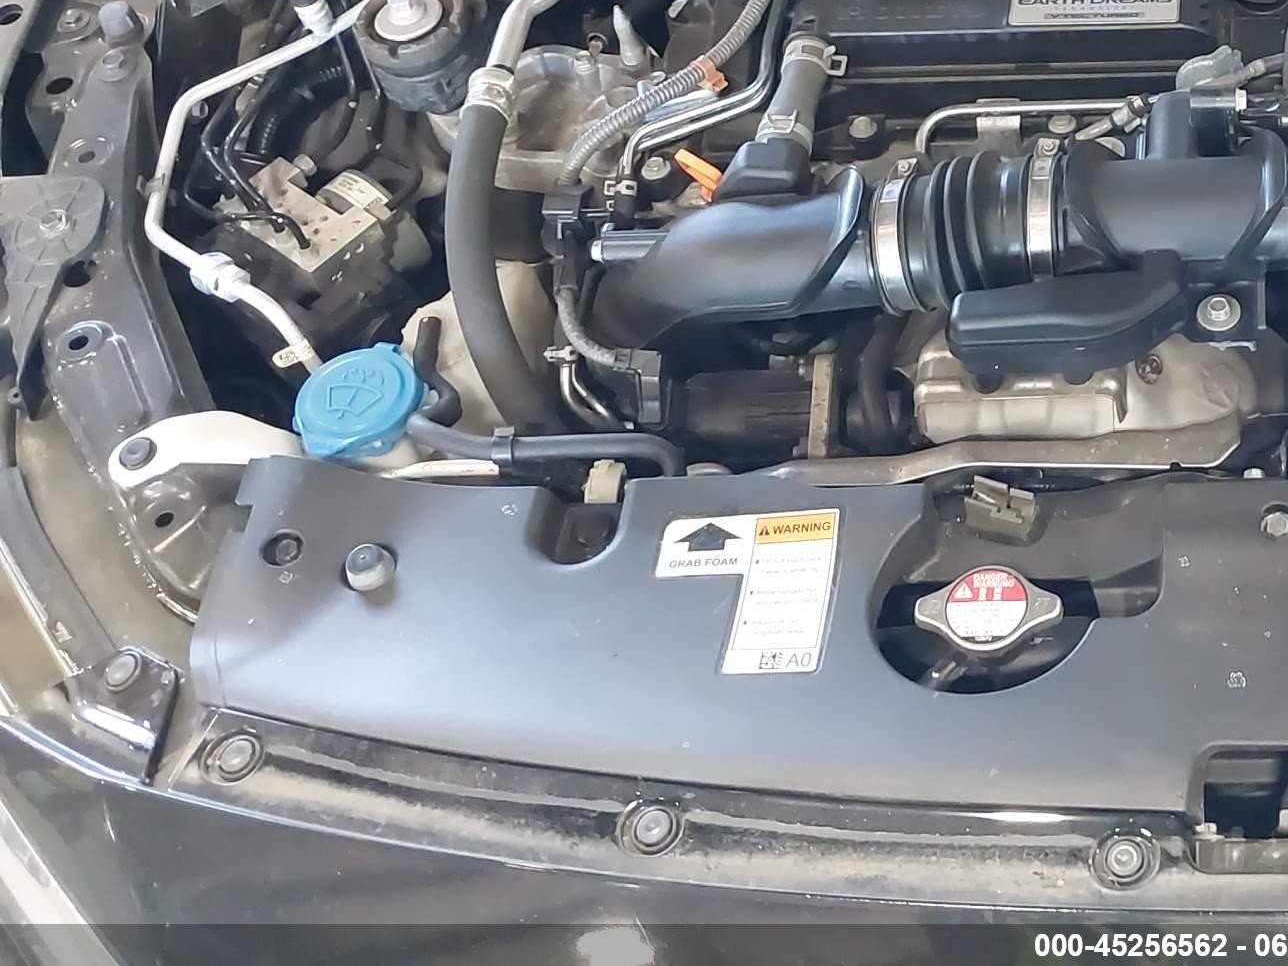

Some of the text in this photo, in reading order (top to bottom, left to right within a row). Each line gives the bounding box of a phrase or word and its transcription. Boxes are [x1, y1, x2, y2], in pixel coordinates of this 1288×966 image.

[773, 521, 831, 535] WARNING
[669, 556, 738, 569] GRAB FOAM
